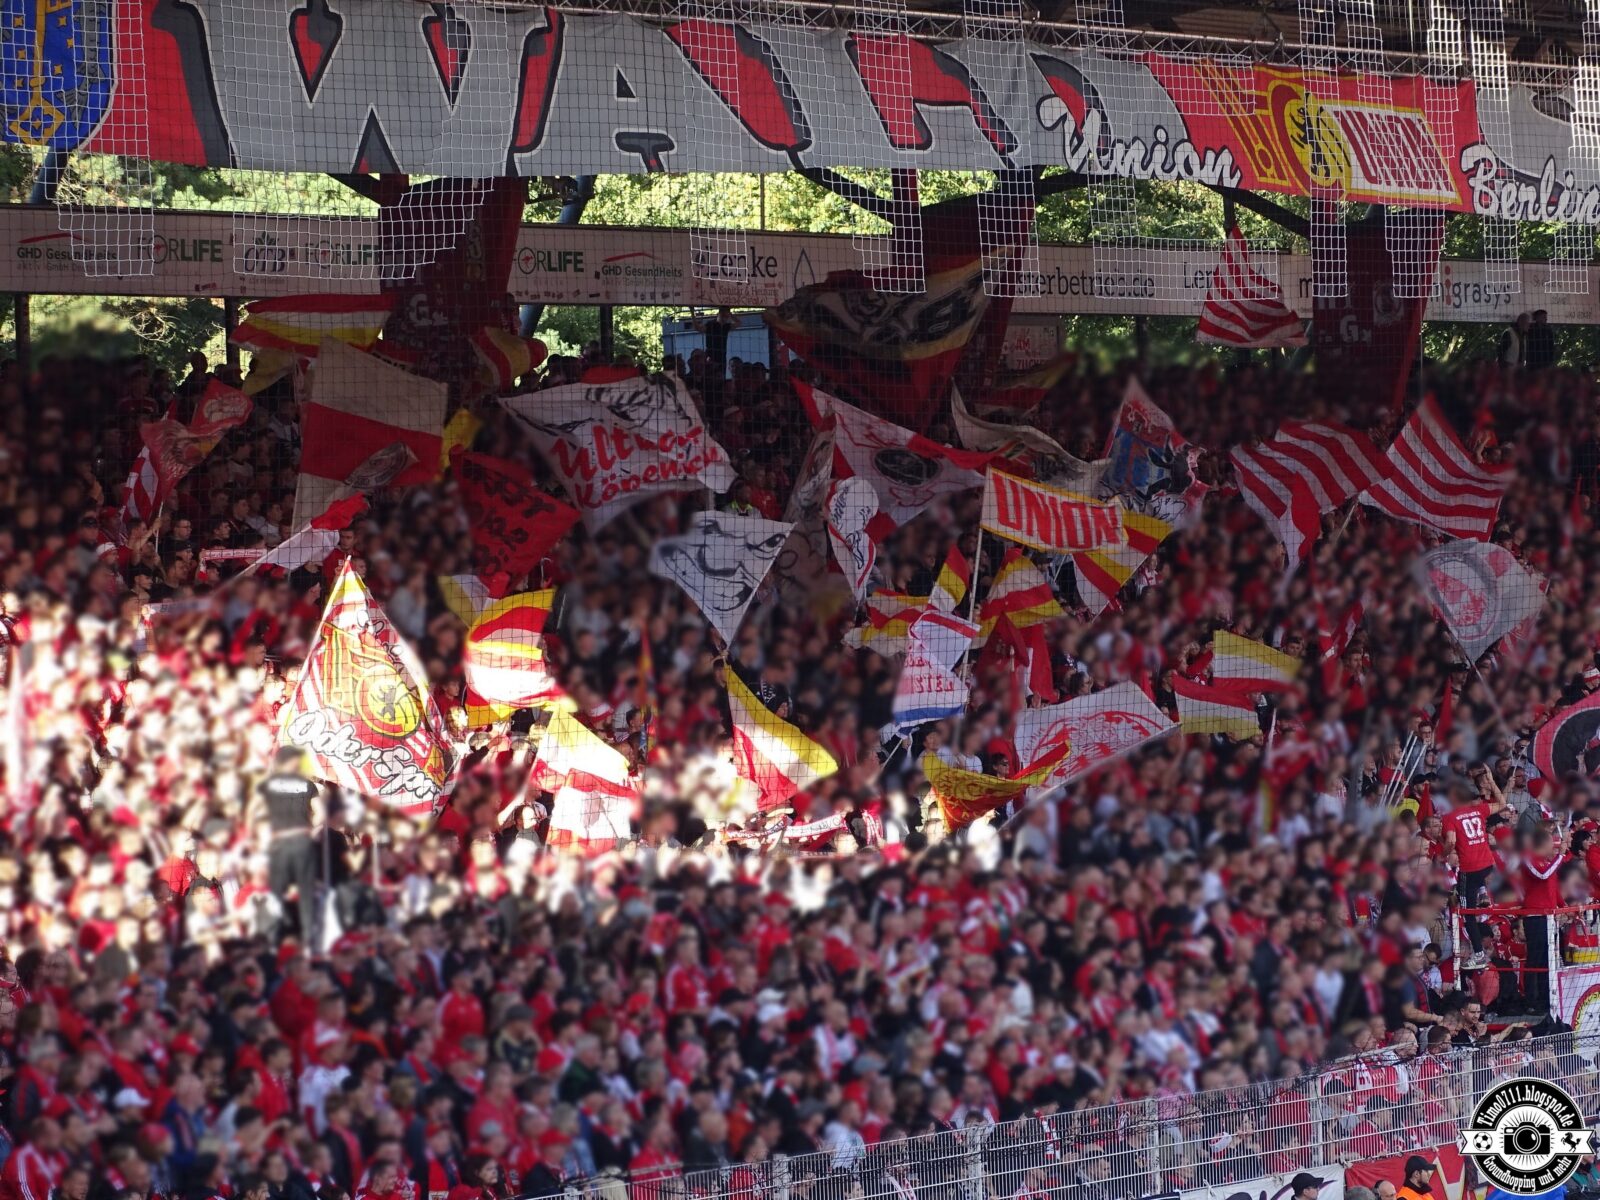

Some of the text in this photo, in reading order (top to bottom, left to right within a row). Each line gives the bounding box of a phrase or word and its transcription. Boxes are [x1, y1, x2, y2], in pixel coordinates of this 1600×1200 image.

[1037, 94, 1600, 224] Union Berlin
[1333, 109, 1455, 192] UNION
[17, 247, 42, 259] GHD
[304, 240, 380, 269] FORLIF
[513, 247, 585, 275] ORLIFE
[601, 265, 683, 278] GHD GesundHeits
[991, 472, 1121, 549] UNION
[1462, 817, 1485, 839] 02
